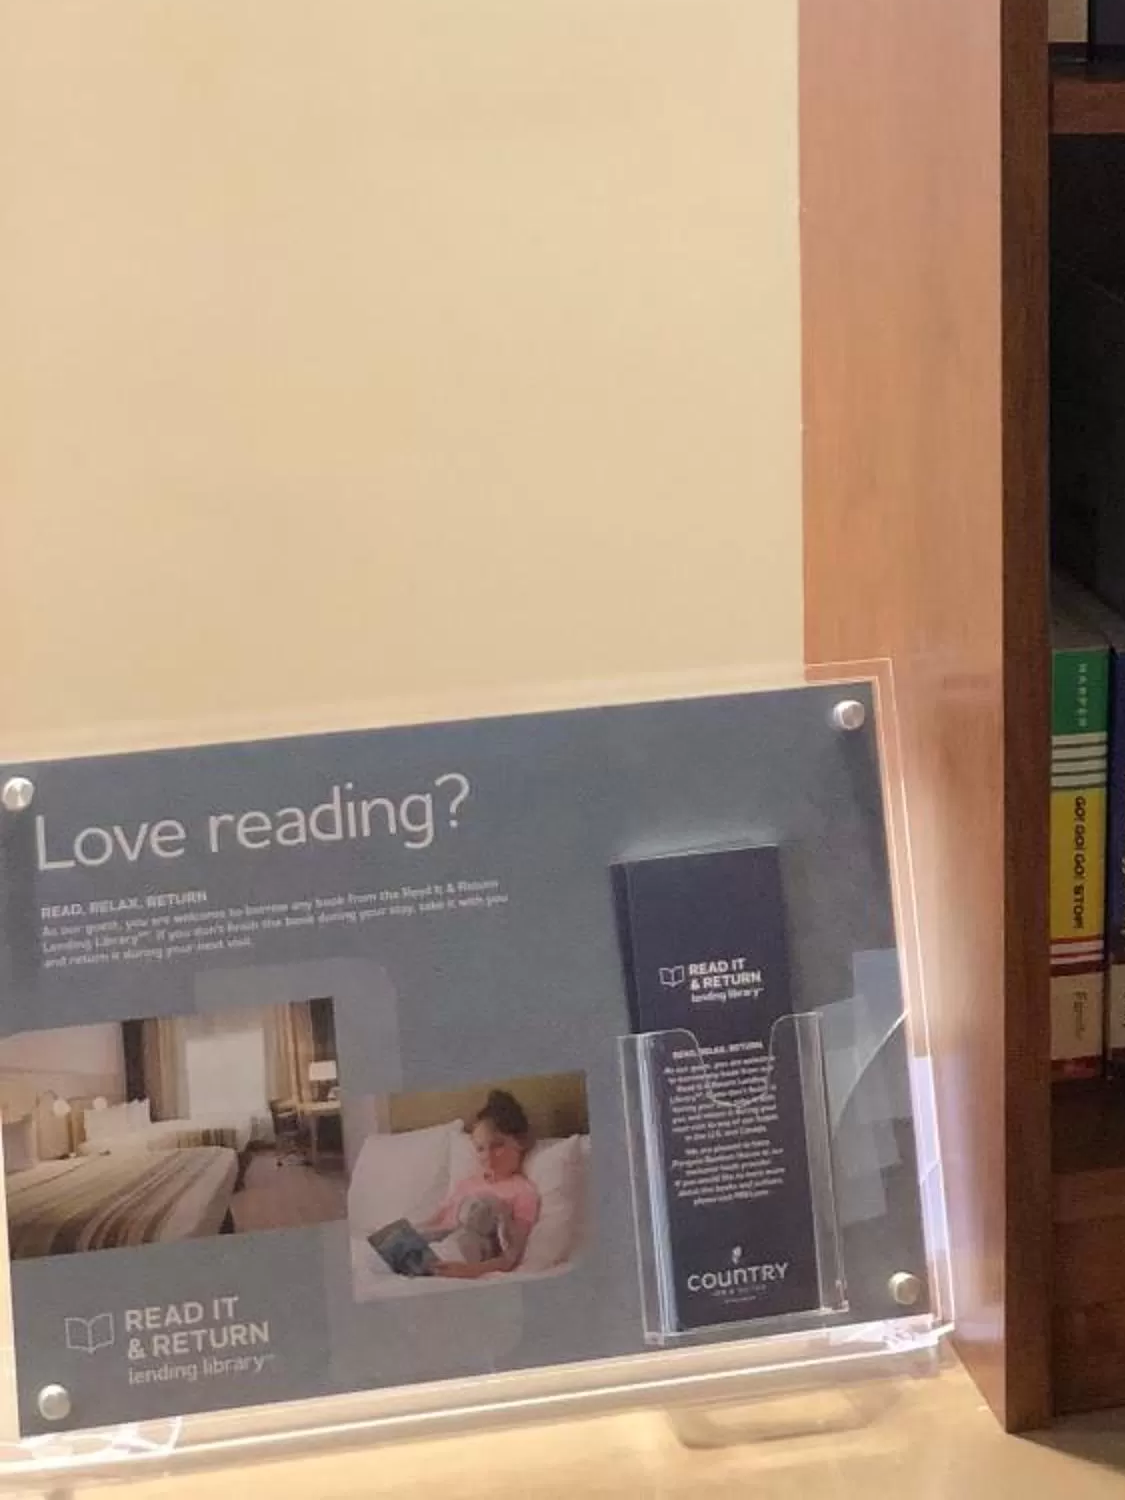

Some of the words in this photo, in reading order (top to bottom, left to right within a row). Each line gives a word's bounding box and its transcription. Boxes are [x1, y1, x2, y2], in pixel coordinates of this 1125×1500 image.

[1074, 795, 1087, 821] GO!
[34, 814, 187, 872] Love
[207, 772, 470, 852] reading?
[1073, 823, 1086, 849] GO!
[1073, 853, 1086, 878] GO!
[688, 959, 729, 976] READ
[731, 957, 747, 971] IT
[690, 978, 701, 991] &
[703, 970, 762, 989] RETURN
[687, 1261, 789, 1292] COUNTRY
[124, 1301, 205, 1333] READ
[212, 1296, 239, 1321] IT
[127, 1337, 146, 1361] &
[151, 1320, 270, 1358] RETURN
[127, 1361, 198, 1386] lending
